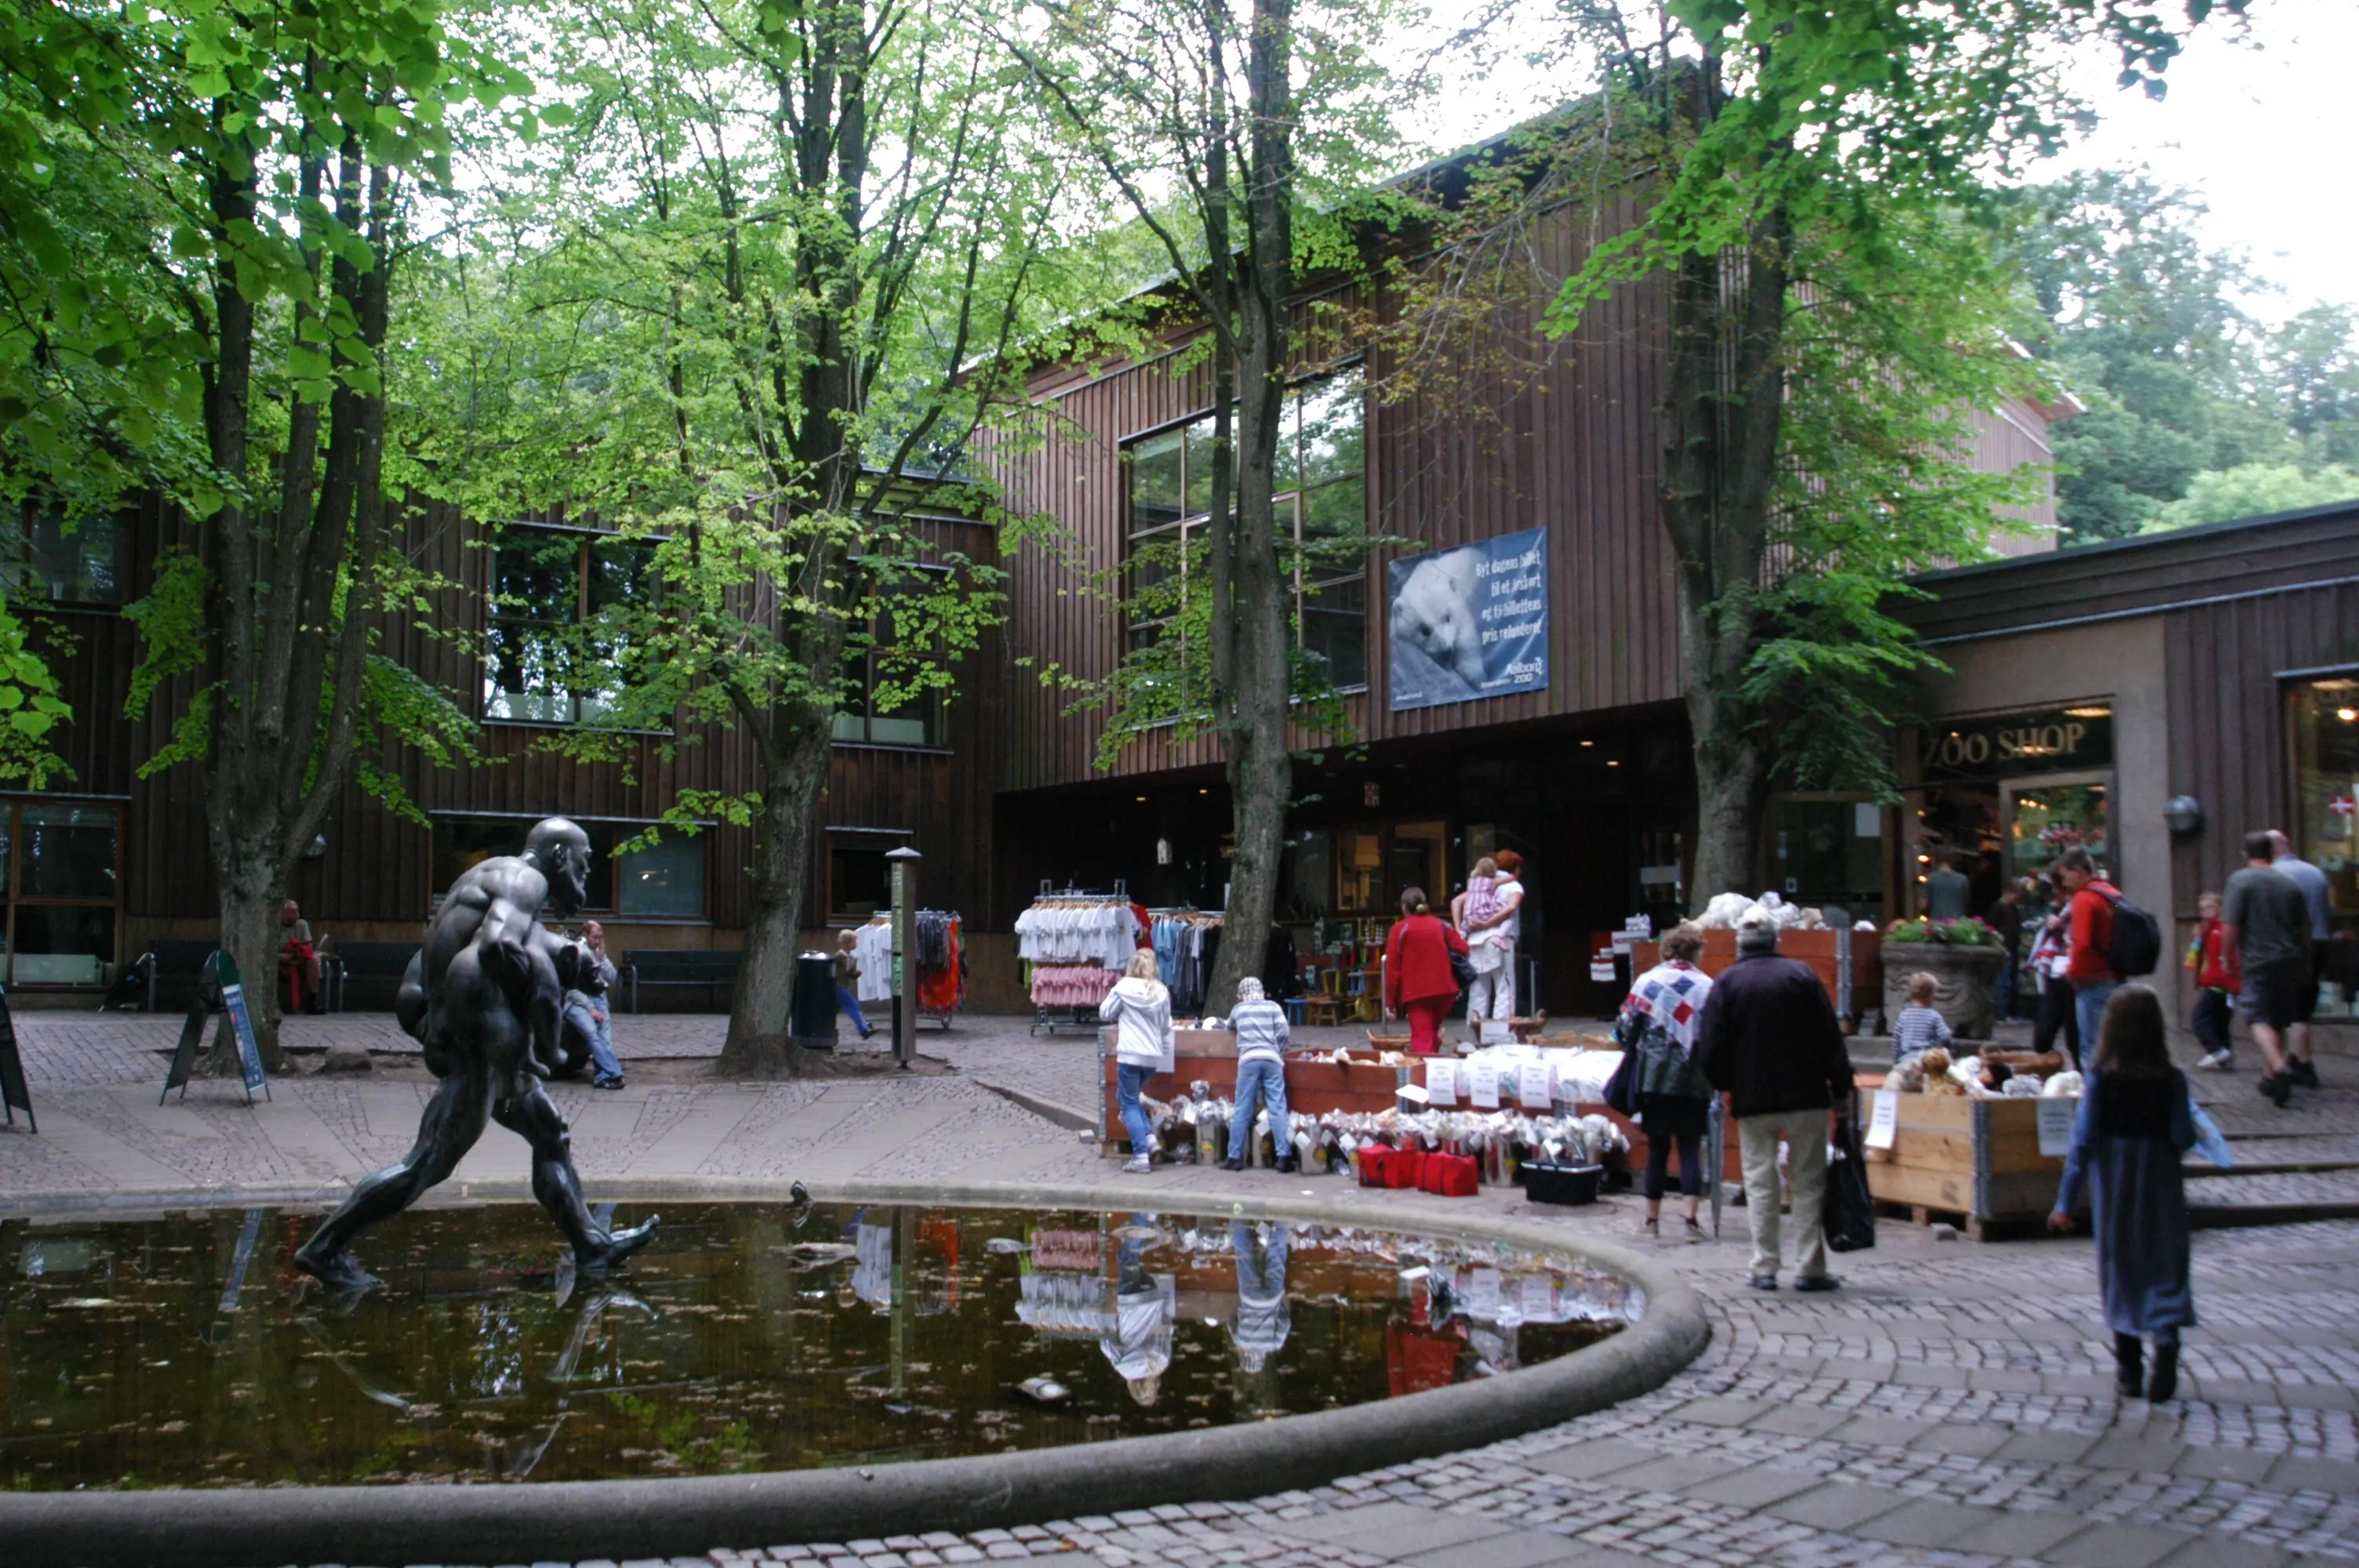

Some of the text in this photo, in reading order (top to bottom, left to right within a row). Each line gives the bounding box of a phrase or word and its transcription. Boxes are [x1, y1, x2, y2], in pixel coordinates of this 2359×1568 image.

[1476, 550, 1541, 578] Byt dagens billet
[1491, 581, 1500, 597] til
[1501, 579, 1510, 593] et
[1481, 607, 1492, 621] og
[1482, 627, 1498, 645] pris
[1924, 722, 2086, 766] ZOO SHOP
